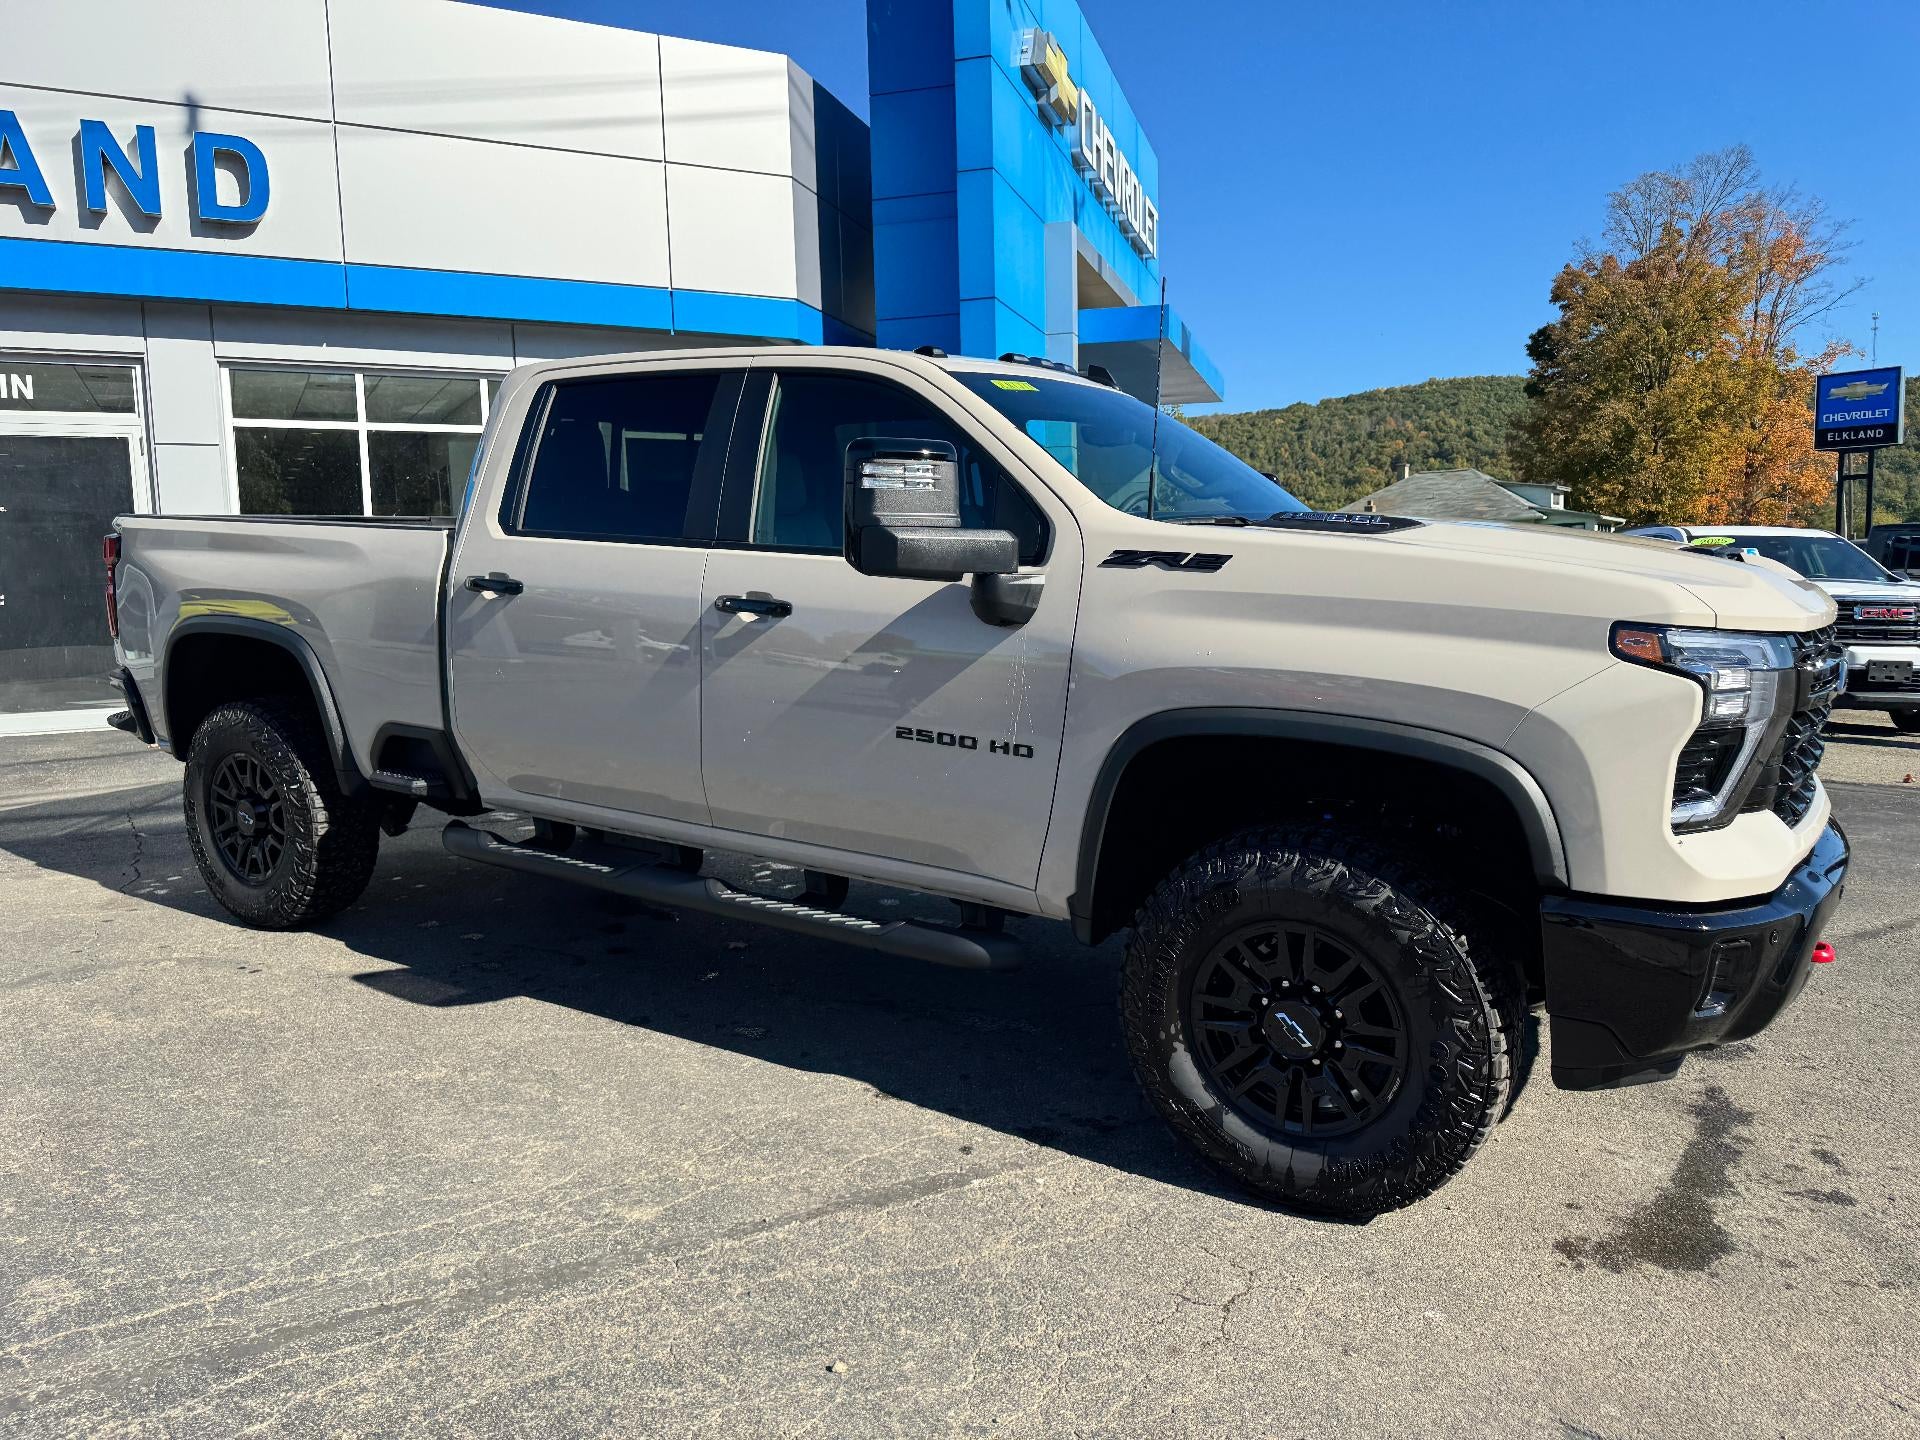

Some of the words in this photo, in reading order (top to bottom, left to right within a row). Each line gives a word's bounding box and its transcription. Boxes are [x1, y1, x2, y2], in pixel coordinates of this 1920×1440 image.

[1081, 87, 1159, 259] CHEVROLET
[1823, 408, 1891, 423] CHEVROLET
[1827, 429, 1884, 441] ELKLAND
[1097, 549, 1233, 573] ZR2
[1862, 607, 1915, 618] GMC
[896, 726, 978, 750] 2500
[989, 740, 1034, 758] HD
